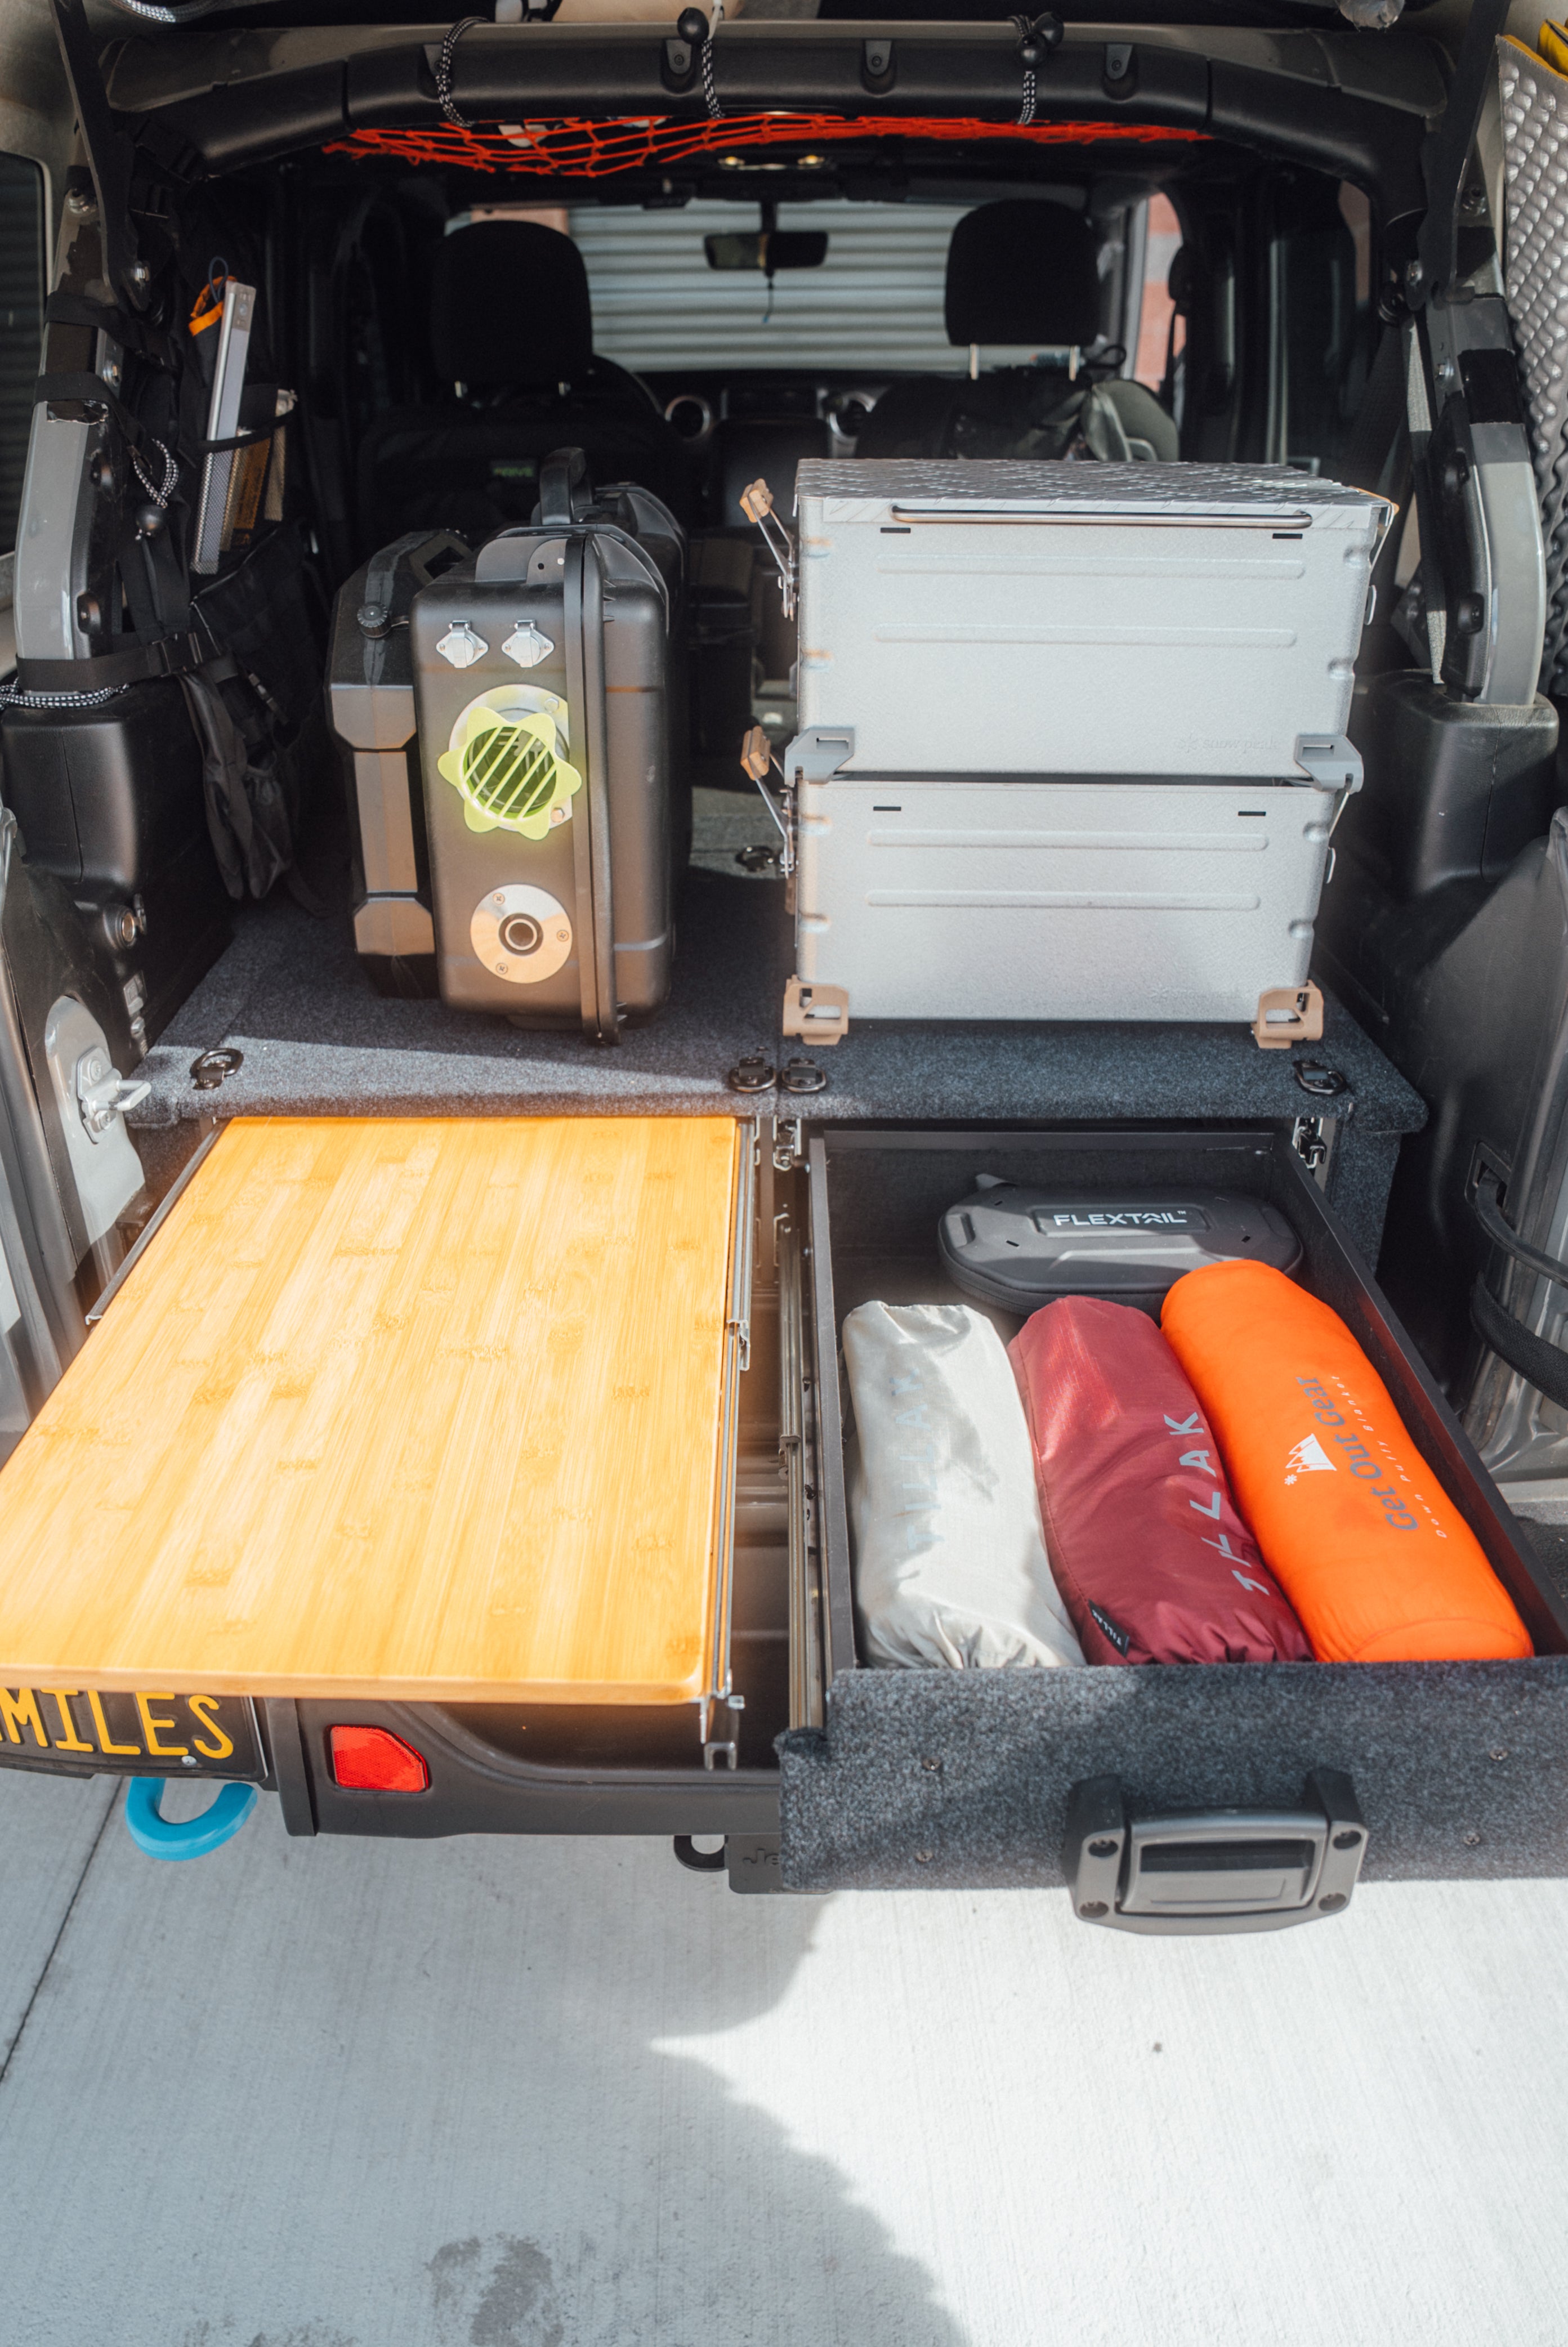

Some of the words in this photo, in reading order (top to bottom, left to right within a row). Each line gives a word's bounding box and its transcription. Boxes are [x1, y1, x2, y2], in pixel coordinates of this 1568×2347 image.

[1203, 739, 1240, 749] snow
[1243, 734, 1278, 754] peak
[1296, 1376, 1346, 1427] Gear
[1331, 1375, 1374, 1432] Blanket
[889, 1367, 945, 1551] TILLAK
[1333, 1433, 1382, 1479] Out
[1377, 1440, 1411, 1482] Puffy
[1163, 1411, 1270, 1597] TILLAK
[1370, 1486, 1419, 1531] Get
[1414, 1494, 1447, 1539] Down
[0, 1688, 234, 1759] MILES
